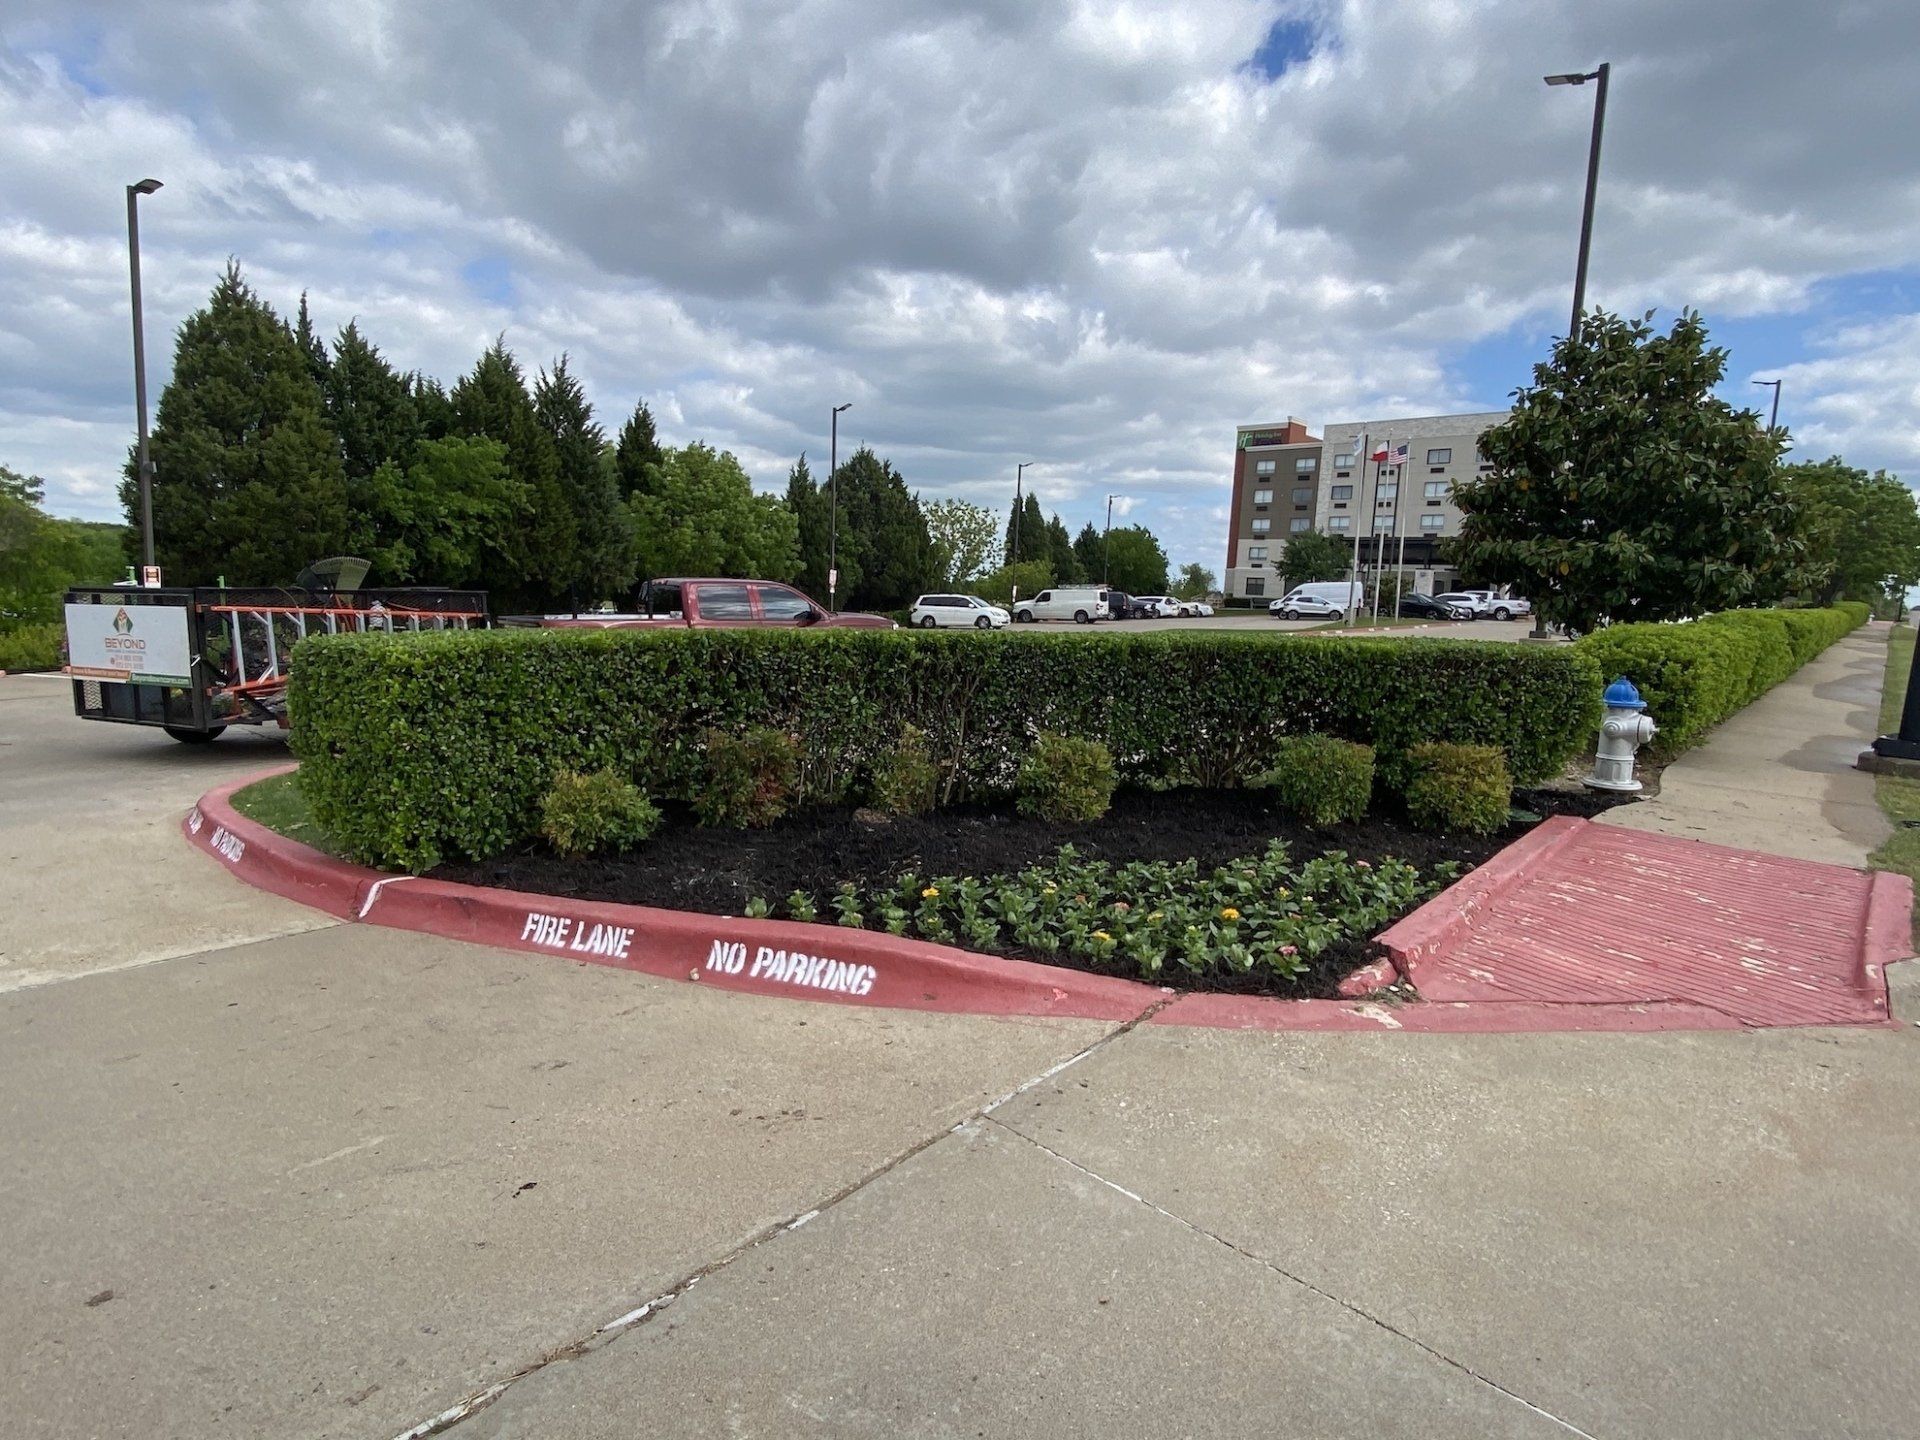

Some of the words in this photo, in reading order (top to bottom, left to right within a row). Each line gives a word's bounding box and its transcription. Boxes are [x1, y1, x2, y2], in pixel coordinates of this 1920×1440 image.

[104, 637, 146, 650] BEYOND
[520, 912, 571, 949] FIRE
[569, 920, 635, 959] LANE
[706, 939, 747, 975] NO
[749, 946, 877, 996] PARKING
